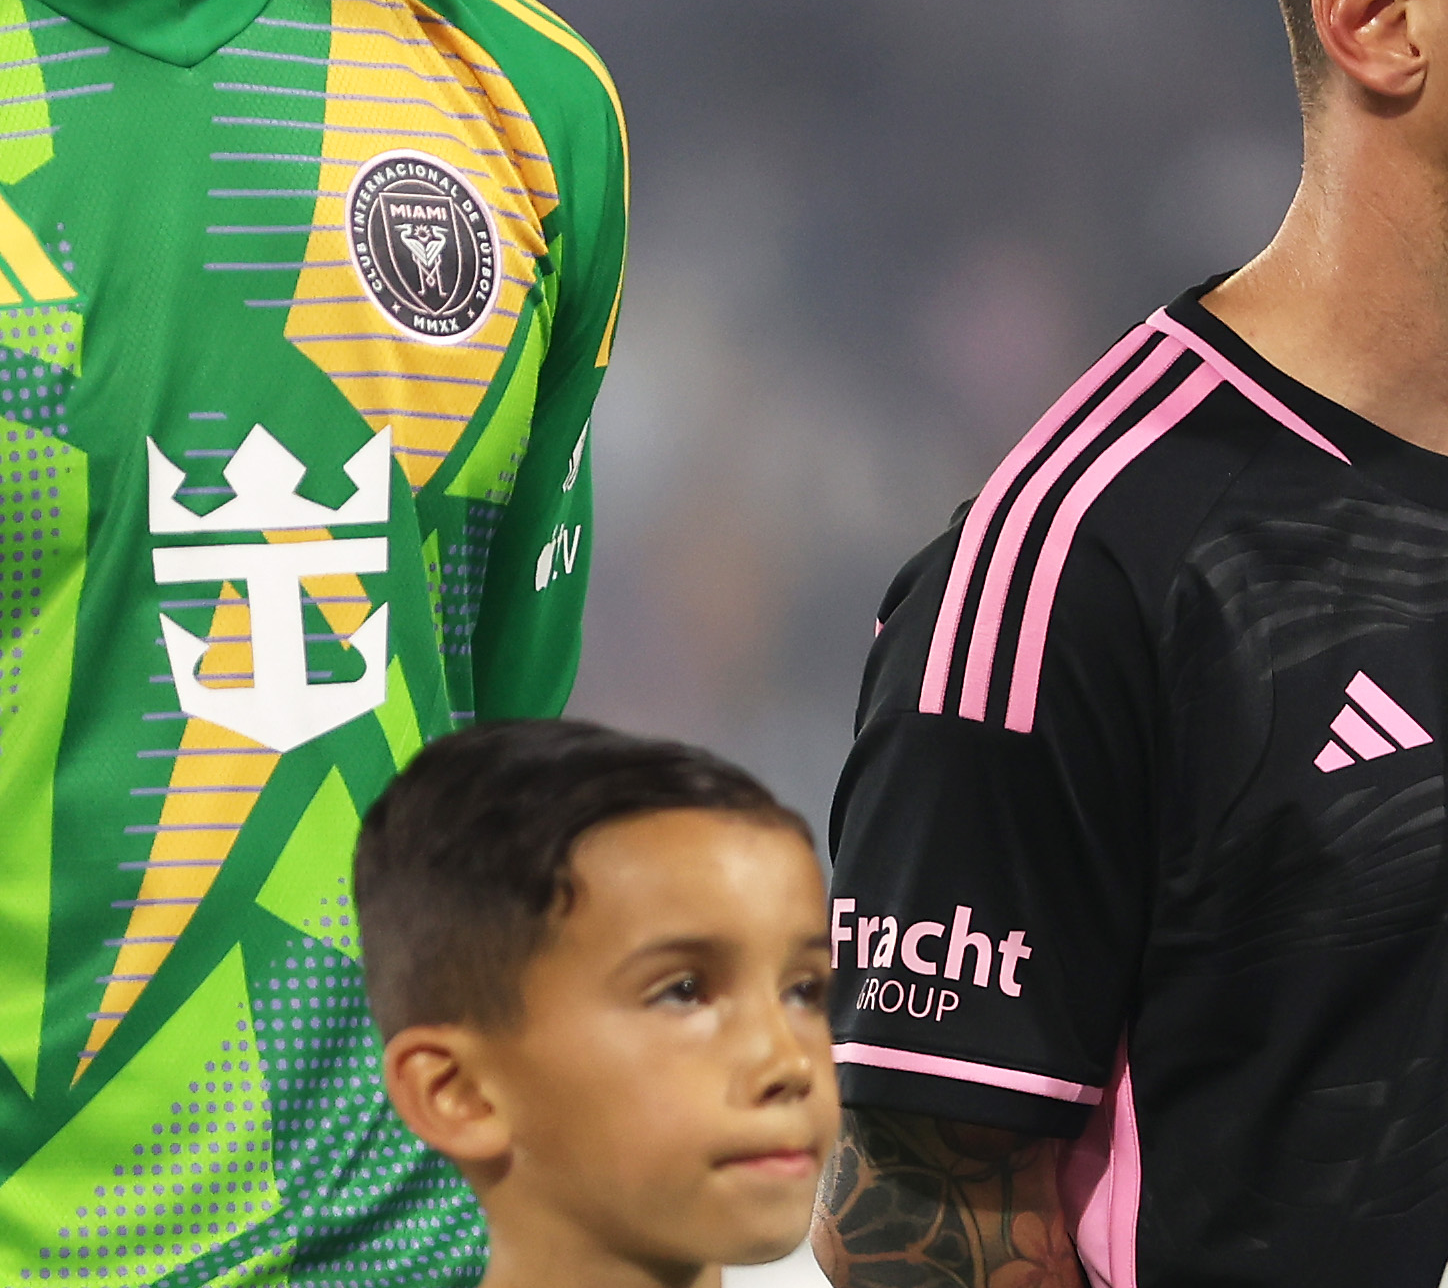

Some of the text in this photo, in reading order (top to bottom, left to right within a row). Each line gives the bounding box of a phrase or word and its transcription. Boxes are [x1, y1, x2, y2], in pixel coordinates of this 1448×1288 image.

[354, 163, 458, 233] INTERNACIONAL
[389, 203, 448, 221] MIAMI
[461, 199, 480, 223] DE
[356, 243, 383, 294] CLUB
[413, 314, 461, 333] MMXX
[831, 897, 1033, 998] Fracht
